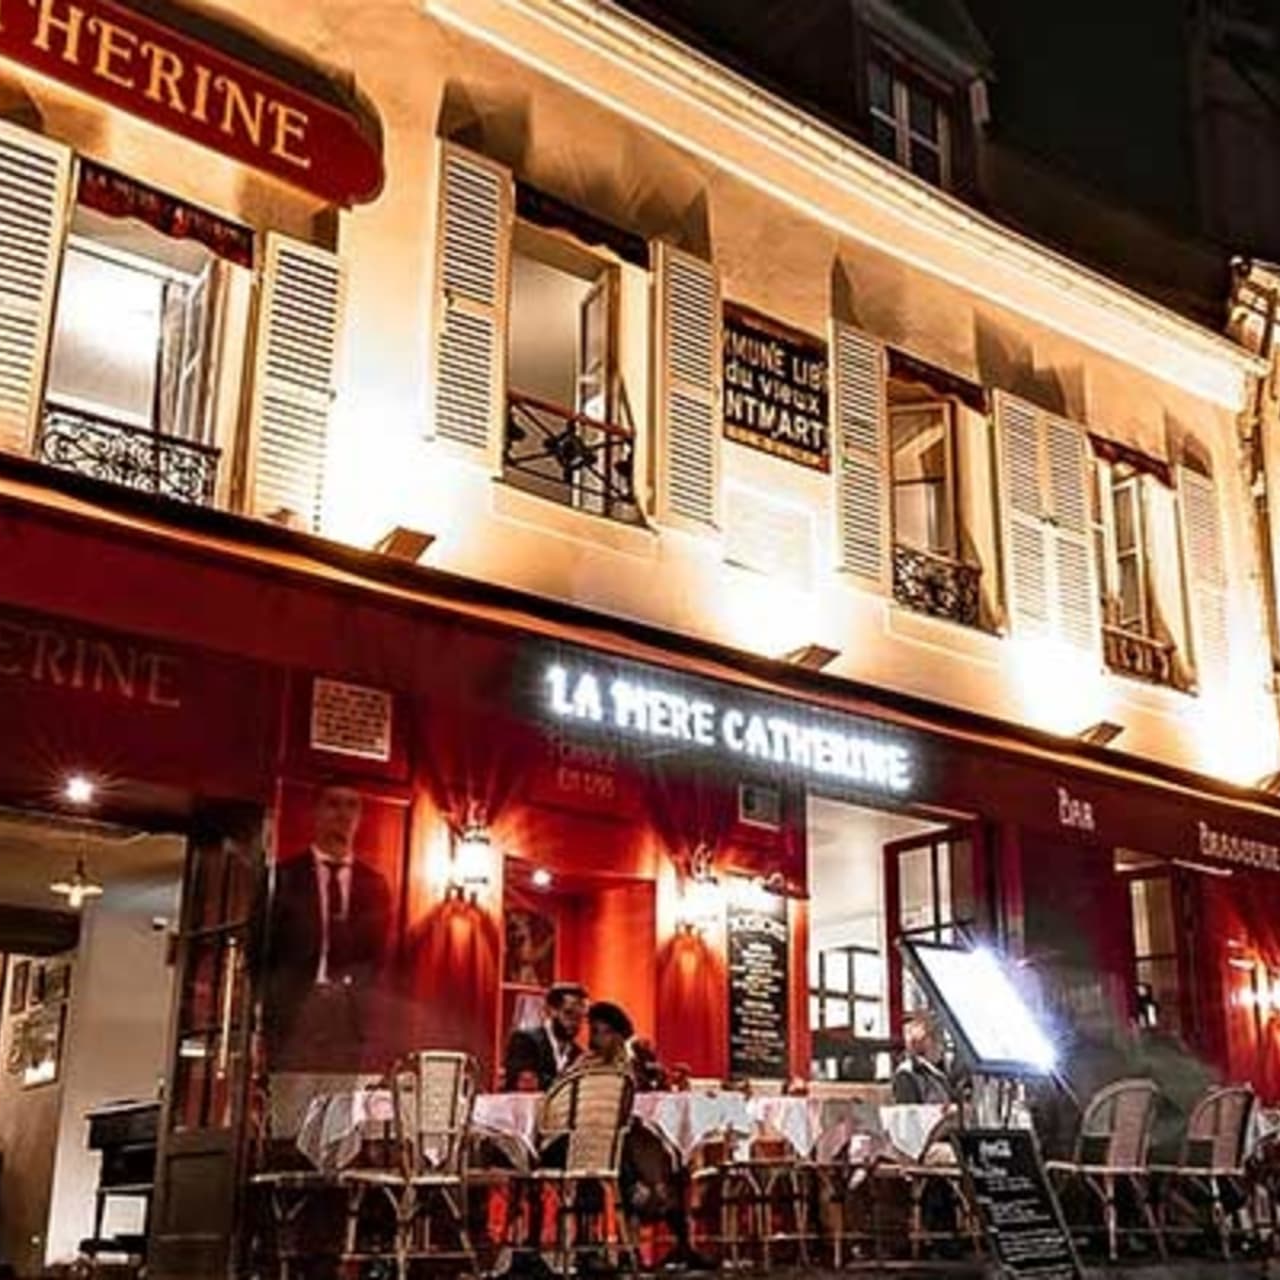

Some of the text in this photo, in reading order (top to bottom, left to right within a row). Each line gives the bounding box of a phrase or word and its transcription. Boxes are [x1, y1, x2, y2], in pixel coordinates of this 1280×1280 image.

[726, 359, 754, 389] du
[726, 389, 828, 452] NTMART
[544, 664, 603, 721] LA
[722, 709, 913, 792] CATHERINE
